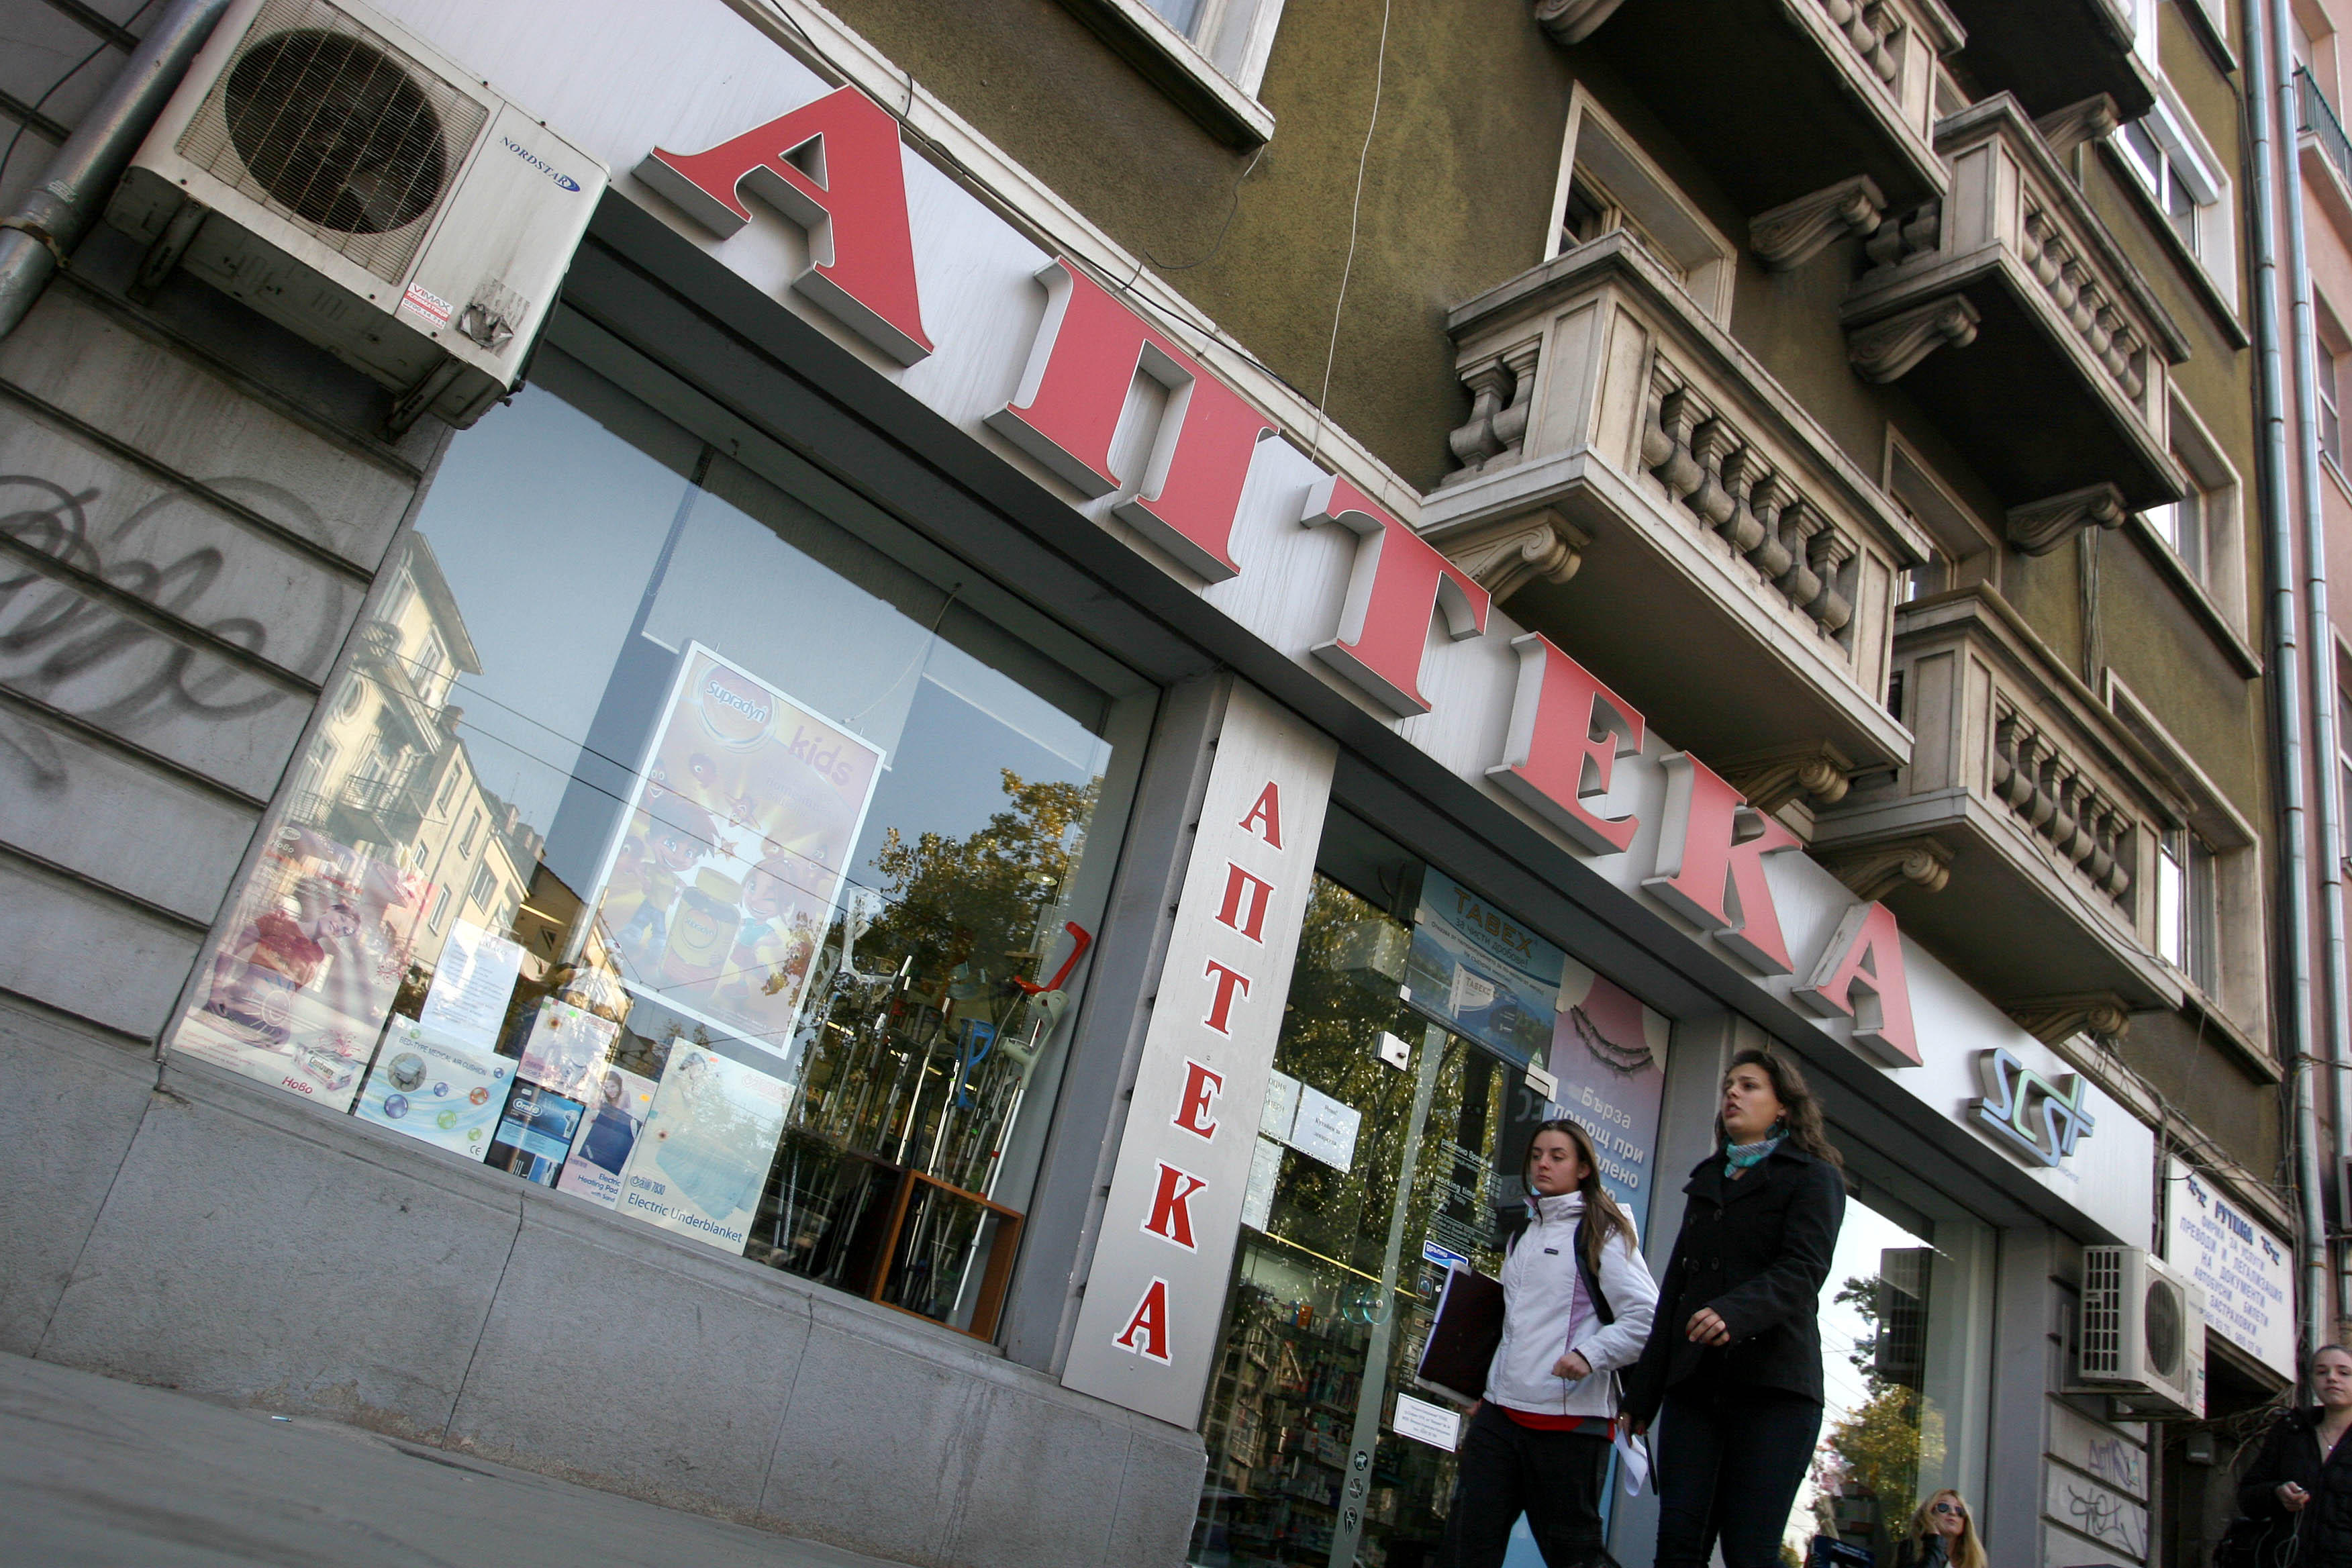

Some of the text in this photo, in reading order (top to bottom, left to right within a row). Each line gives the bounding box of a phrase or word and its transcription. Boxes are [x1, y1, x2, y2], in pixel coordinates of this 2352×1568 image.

[499, 136, 568, 186] NORDSTAR
[413, 284, 450, 311] VIMAX
[632, 84, 1924, 1068] АПТЕКА
[706, 681, 766, 723] Supradyn
[789, 725, 853, 787] kids
[1454, 887, 1532, 959] TABEX
[1466, 977, 1491, 995] ТАБЕКС
[309, 1056, 334, 1077] Centrum
[399, 1036, 430, 1054] BED-TYPE
[429, 1046, 451, 1063] MEDICAL
[462, 1059, 487, 1076] CUSHION
[1112, 779, 1287, 1367] АПТЕКА
[281, 1075, 313, 1095] Ново
[1581, 1086, 1631, 1130] Бърза
[1614, 1137, 1644, 1164] при
[577, 1175, 618, 1195] Heating Pad
[599, 1173, 621, 1187] Electric
[628, 1192, 743, 1243] Electric Underblanket
